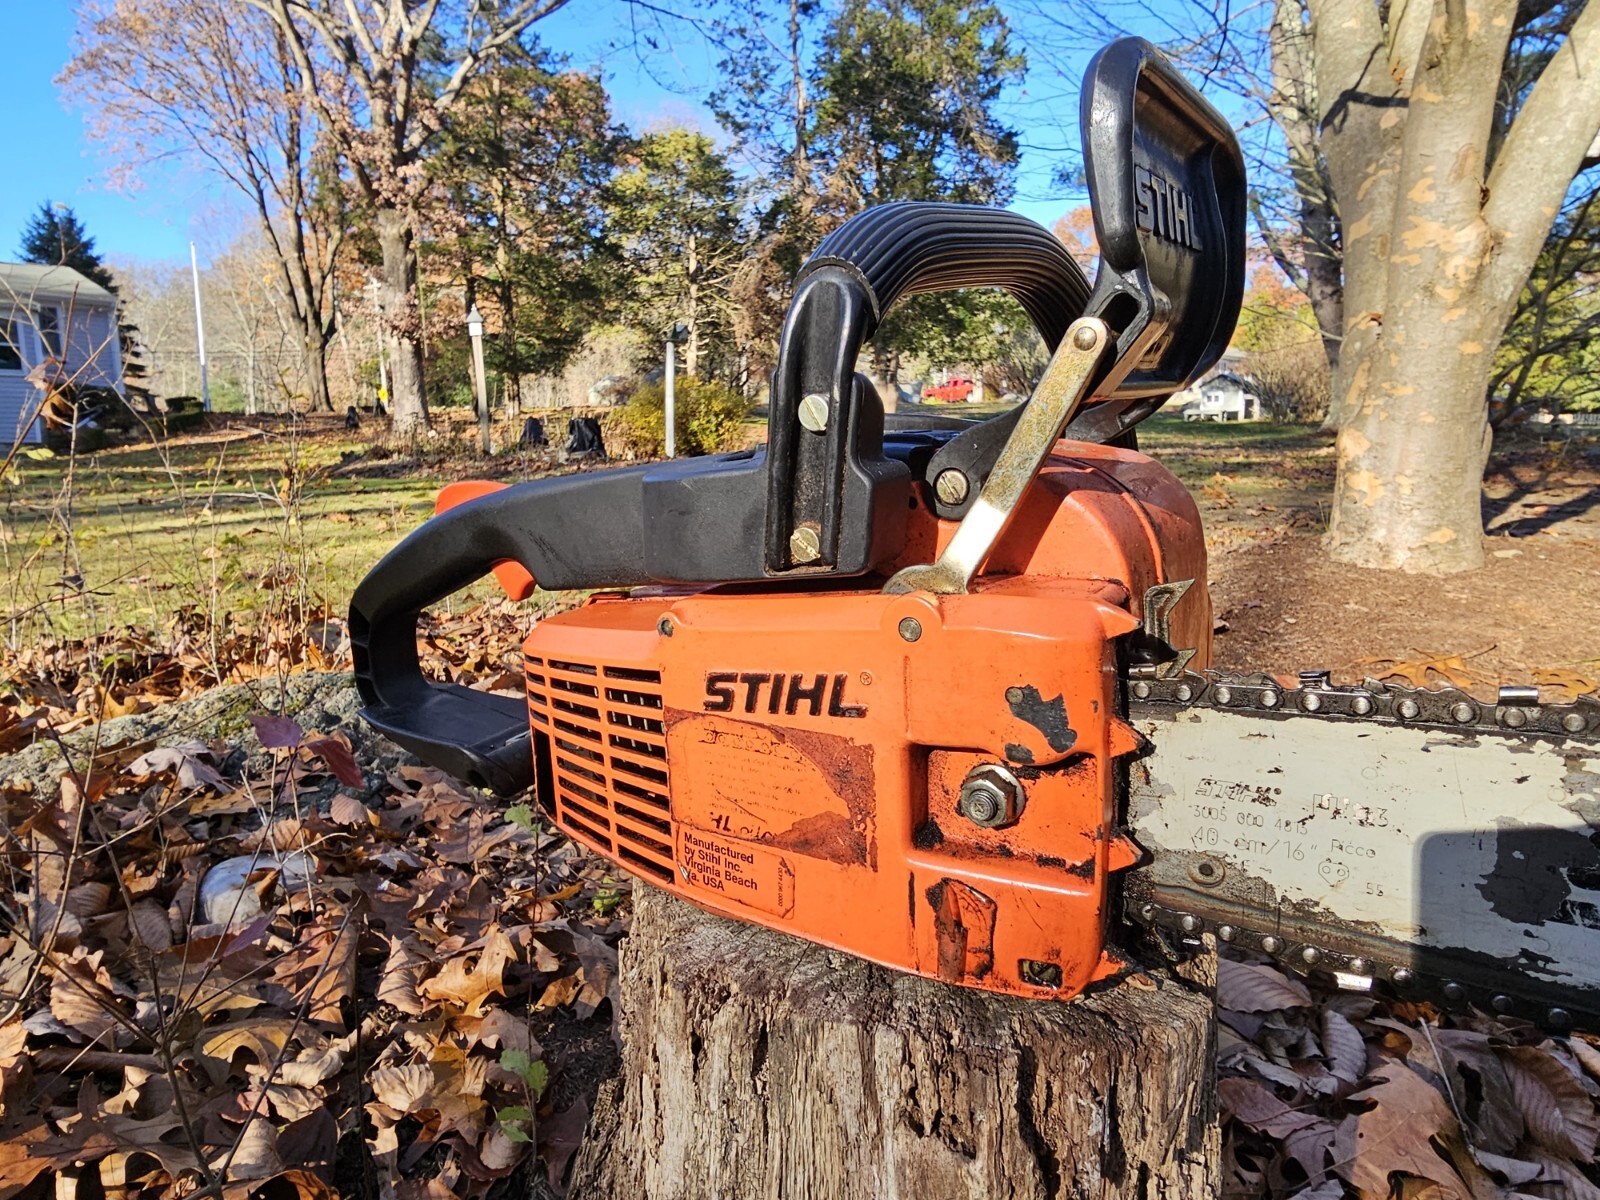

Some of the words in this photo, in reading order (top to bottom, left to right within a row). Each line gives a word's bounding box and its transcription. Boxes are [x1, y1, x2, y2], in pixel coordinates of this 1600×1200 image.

[1134, 165, 1203, 251] STIHL
[703, 672, 868, 718] STIHL
[684, 832, 754, 865] Manufactured
[684, 843, 695, 857] by
[698, 849, 721, 866] Stihl
[724, 858, 743, 873] Inc.
[684, 855, 721, 878] Virginia
[724, 870, 758, 890] Beach
[702, 874, 725, 892] USA
